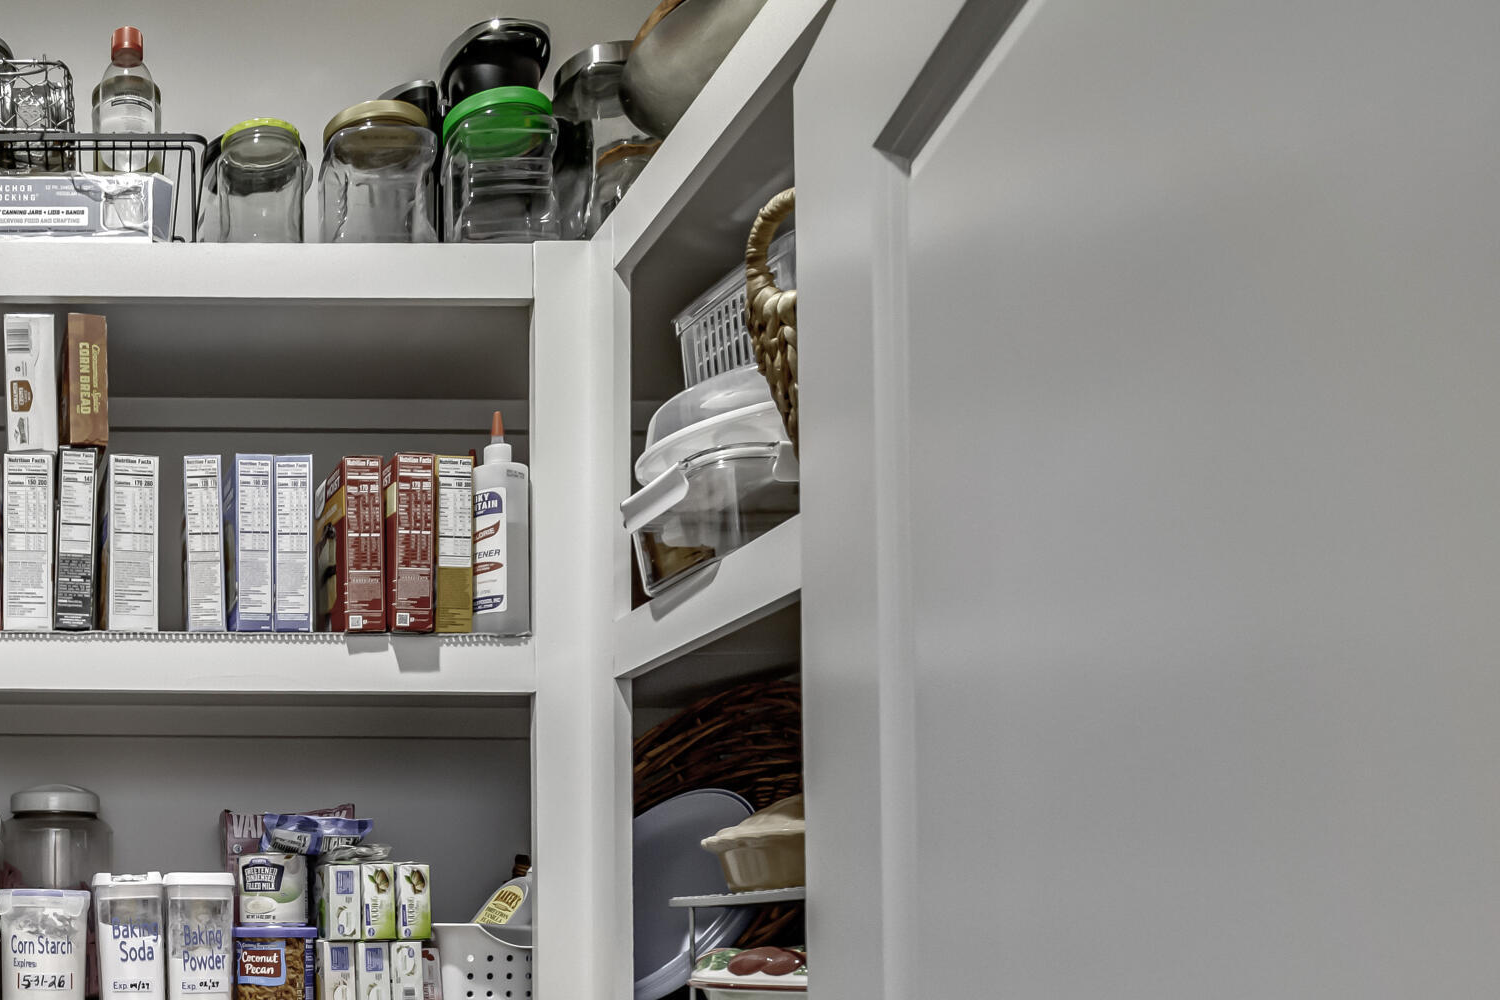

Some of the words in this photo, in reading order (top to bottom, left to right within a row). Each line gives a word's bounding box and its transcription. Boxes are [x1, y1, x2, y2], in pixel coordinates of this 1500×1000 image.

[79, 342, 90, 373] CORN
[80, 376, 91, 414] BREAD
[261, 882, 275, 890] MILK
[112, 917, 159, 943] Baking
[183, 924, 223, 949] Baking
[11, 935, 37, 955] Corn
[38, 935, 73, 955] Starch
[119, 941, 155, 962] Soda
[182, 950, 226, 972] Powder
[241, 951, 279, 964] Coconut
[246, 964, 275, 976] Pecan
